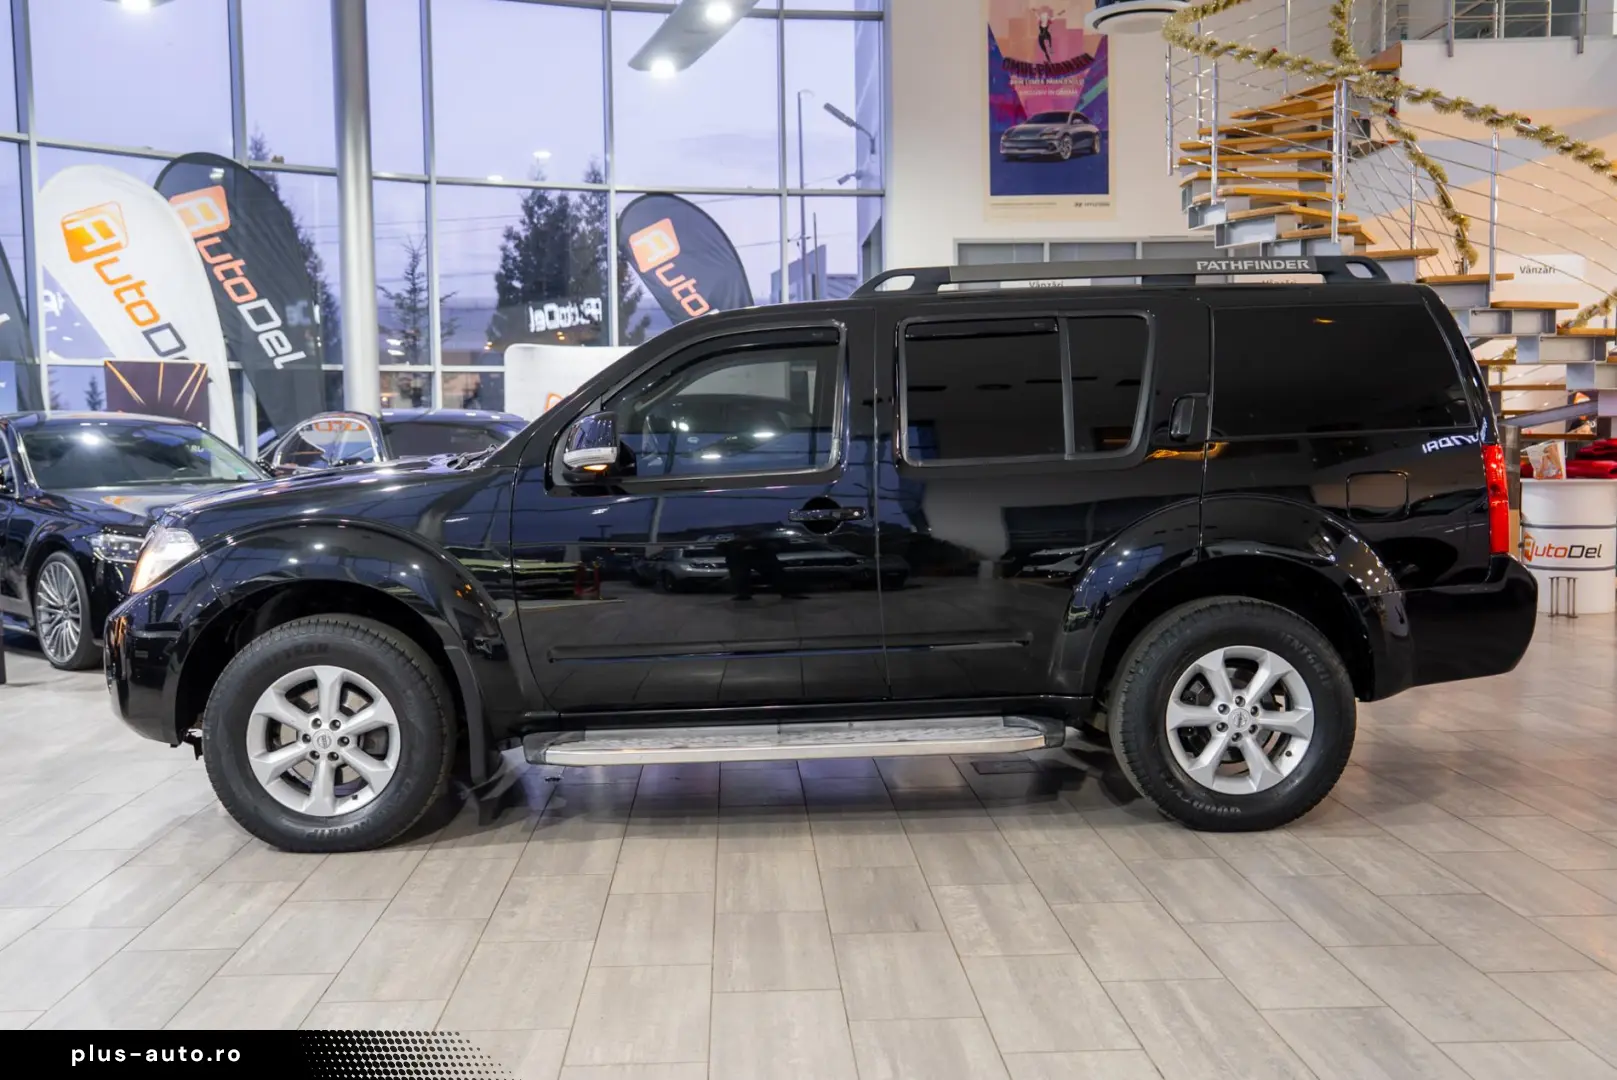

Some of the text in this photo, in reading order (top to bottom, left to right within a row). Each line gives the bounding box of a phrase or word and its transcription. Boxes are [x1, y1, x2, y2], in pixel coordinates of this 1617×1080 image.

[60, 201, 190, 361] AutoD
[629, 218, 720, 317] Auto
[1196, 258, 1310, 272] PATHFINDER
[1523, 532, 1603, 562] AutoDel
